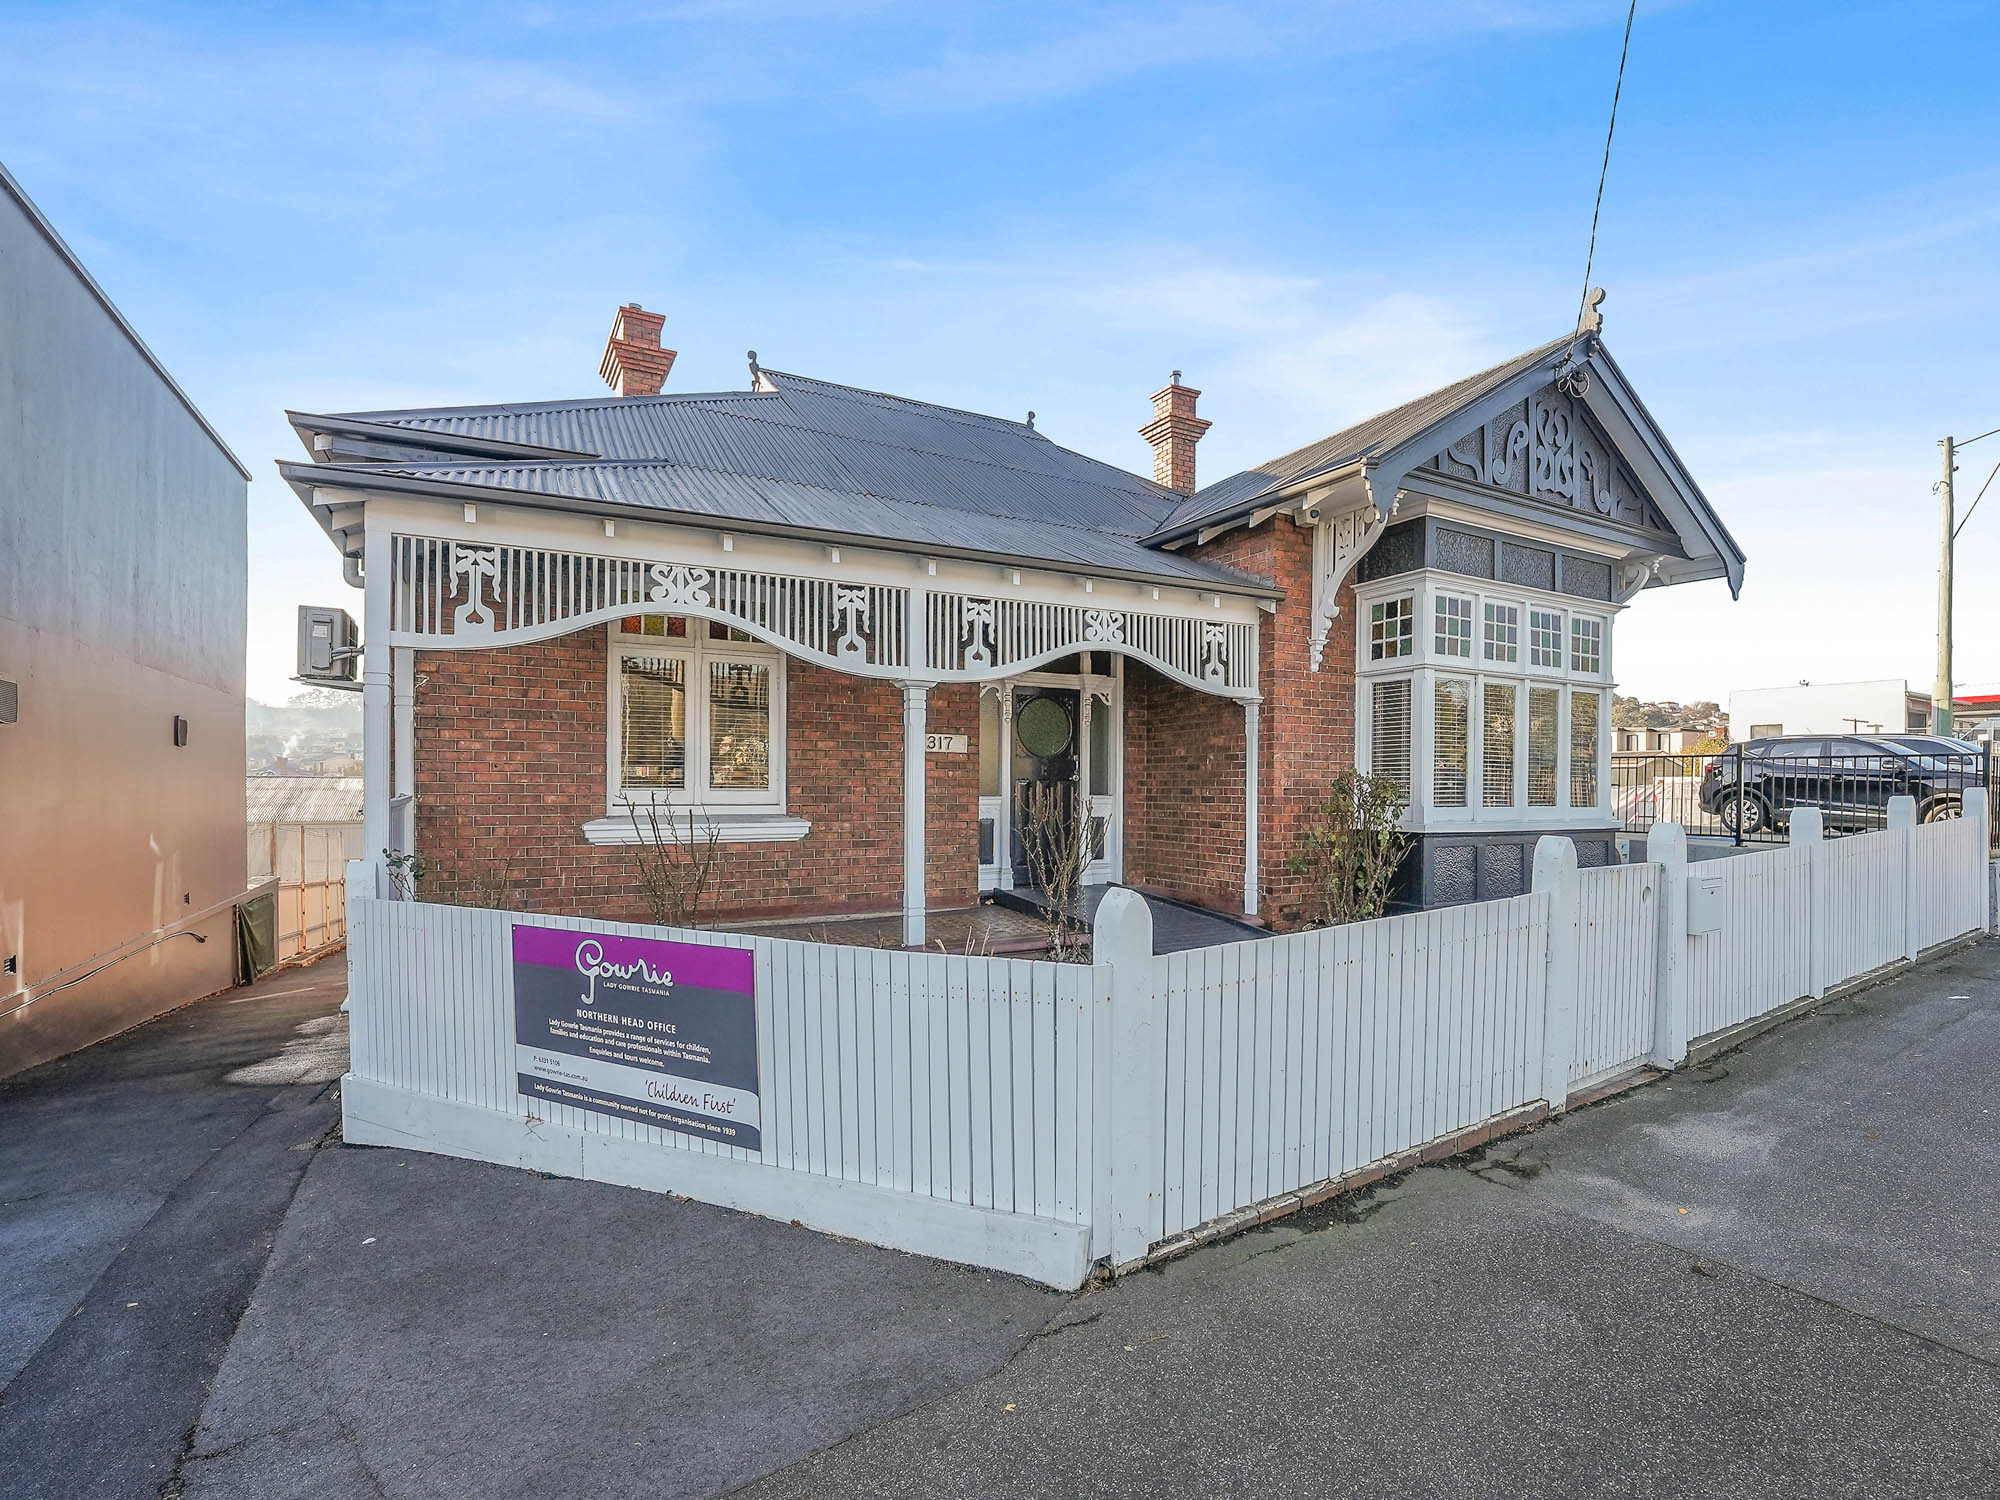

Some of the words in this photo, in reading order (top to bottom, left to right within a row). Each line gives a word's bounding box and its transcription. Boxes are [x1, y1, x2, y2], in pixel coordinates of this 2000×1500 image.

[927, 735, 953, 750] 317
[576, 939, 674, 1005] Gowrie
[603, 981, 617, 989] LADY
[618, 983, 640, 992] GOWRIE
[642, 987, 670, 996] TASMANIA
[576, 1009, 619, 1023] NORTHERN
[621, 1016, 644, 1027] HEAD
[647, 1020, 677, 1033] OFFICE
[548, 1018, 560, 1027] Lady
[579, 1023, 602, 1033] Tasmania
[602, 1028, 625, 1037] provides
[630, 1033, 646, 1043] range
[653, 1038, 676, 1047] services
[676, 1041, 686, 1049] for
[686, 1043, 711, 1055] children,
[579, 1033, 604, 1043] education
[627, 1042, 663, 1054] professionals
[663, 1048, 682, 1057] within
[682, 1051, 711, 1063] Tasmania.
[624, 1053, 639, 1062] tours
[639, 1056, 665, 1066] welcome.
[534, 1083, 545, 1092] Lady
[562, 1089, 583, 1100] Tasmania
[639, 1107, 649, 1115] not
[648, 1109, 657, 1117] for
[657, 1112, 672, 1121] profit
[672, 1116, 706, 1129] organisation
[706, 1124, 721, 1133] since
[722, 1126, 736, 1136] 1939
